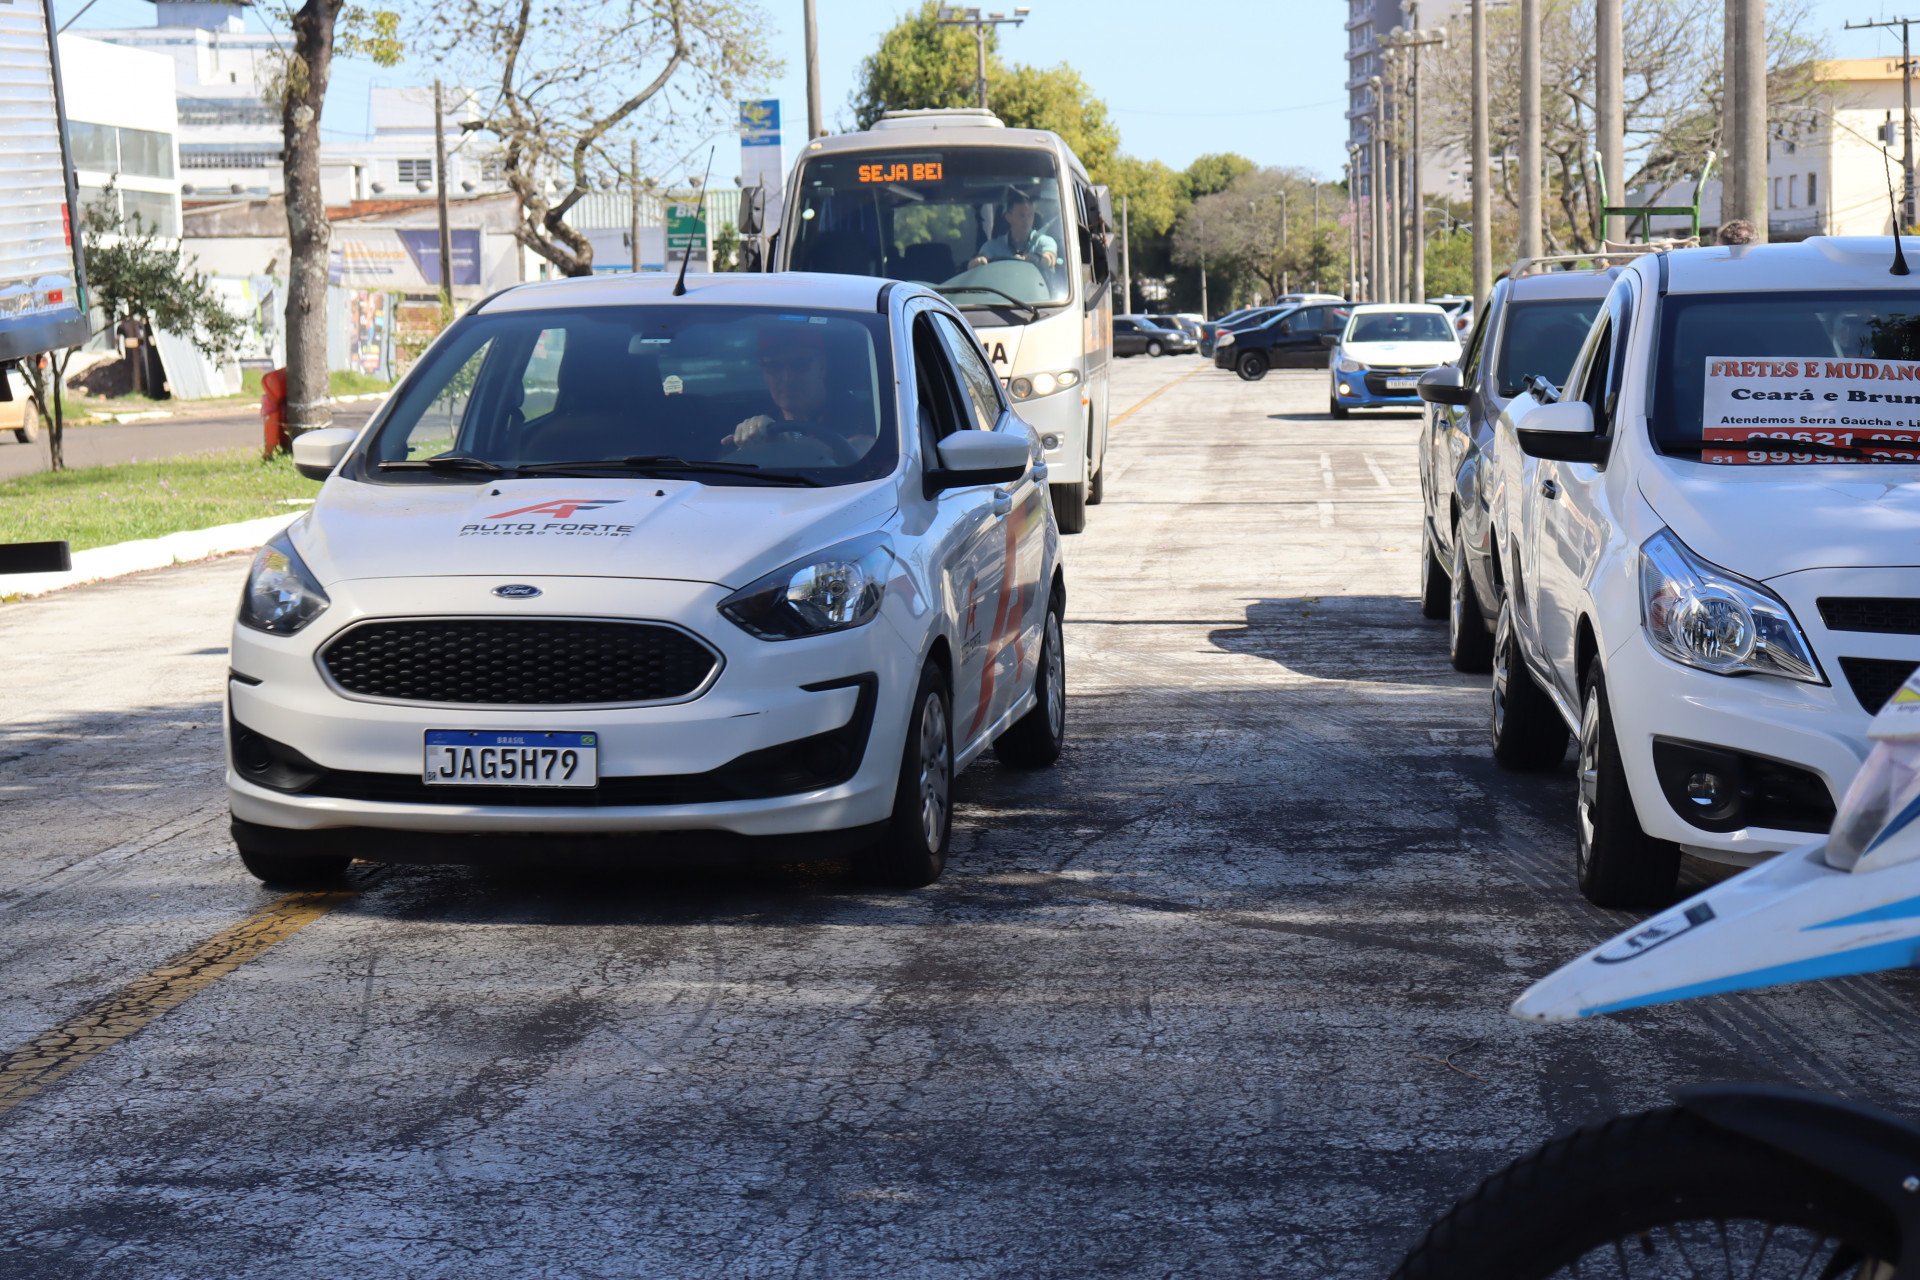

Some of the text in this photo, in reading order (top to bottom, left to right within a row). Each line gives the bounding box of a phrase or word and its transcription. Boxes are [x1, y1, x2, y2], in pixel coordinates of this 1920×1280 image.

[858, 164, 908, 182] SEJA
[1710, 361, 1799, 378] FRETES
[1804, 362, 1820, 378] E
[1731, 388, 1815, 401] Ceará
[1823, 392, 1839, 402] e
[1720, 415, 1795, 424] Atendemos
[1799, 416, 1836, 425] Serra
[1840, 416, 1892, 426] Gaúcha
[461, 523, 635, 533] AUTO FORTE
[496, 736, 525, 744] BRASIL
[440, 747, 578, 780] JAG5H79
